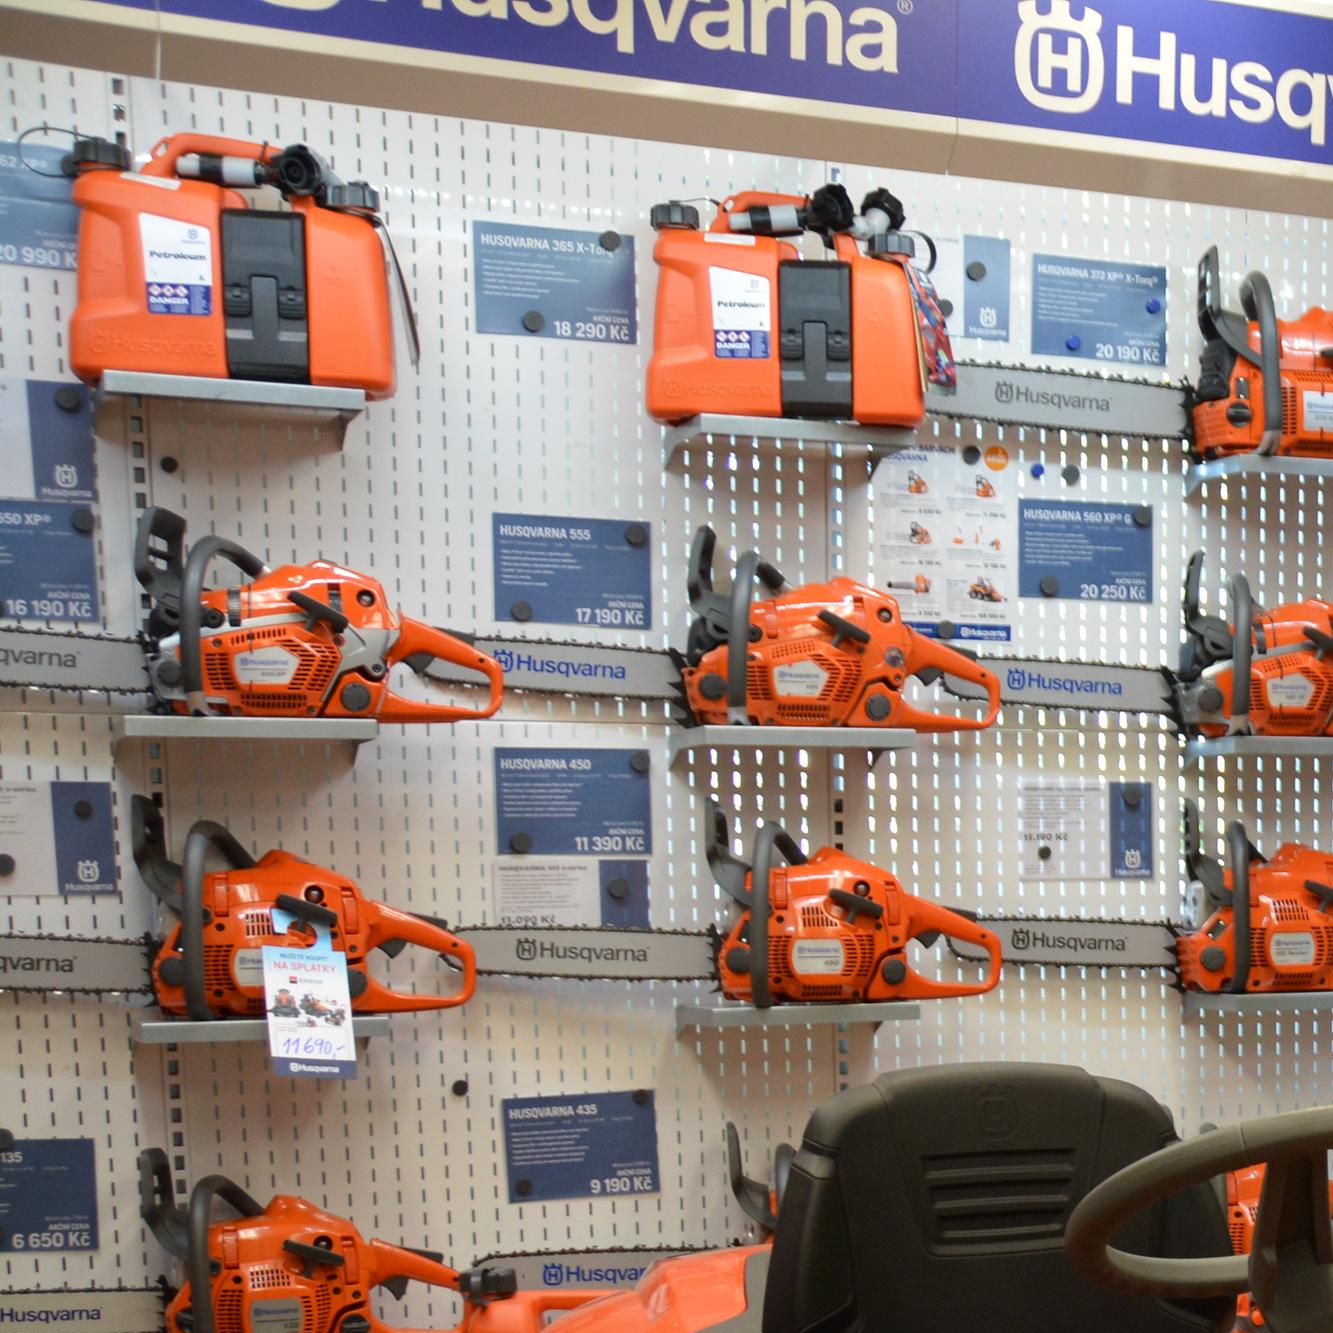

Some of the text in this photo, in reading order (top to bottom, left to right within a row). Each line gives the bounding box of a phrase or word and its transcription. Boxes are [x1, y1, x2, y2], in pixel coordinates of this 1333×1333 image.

[481, 233, 550, 250] HUSQVARNA
[552, 239, 575, 252] 365
[22, 247, 60, 265] 990
[149, 249, 207, 262] Petroleum
[1038, 264, 1105, 281] HUSQVARNA 372
[149, 296, 190, 306] DANGER
[717, 300, 766, 309] Petroleum
[554, 320, 630, 341] 18 290 Kč
[716, 341, 750, 350] DANGER
[1096, 343, 1160, 363] 20 190 Kč
[1016, 384, 1110, 412] Husqvarna
[42, 487, 93, 498] Husqvarna
[1024, 508, 1081, 521] HUSQVARNA
[1083, 510, 1101, 522] 560
[1124, 513, 1132, 524] G
[501, 525, 592, 541] HUSQVARNA 555
[70, 592, 91, 600] CENA
[1081, 584, 1147, 600] 20 250 Kč
[8, 599, 92, 617] 16 190 Kč
[575, 607, 645, 625] 17 190 Kč
[517, 655, 626, 679] Husqvarna
[1029, 672, 1122, 695] Husqvarna
[500, 757, 592, 771] HUSQVARNA 450
[575, 836, 645, 852] 11 390 Kč
[1023, 832, 1052, 842] 15.190
[65, 881, 114, 892] Husqvarna
[1032, 927, 1127, 951] Husqvarna
[539, 941, 648, 964] Husqvarna
[273, 960, 288, 970] NA
[290, 961, 336, 974] SPLÁTKY
[299, 1064, 340, 1073] Husqvarna
[509, 1104, 598, 1120] HUSQVARNA 435
[1, 1152, 23, 1163] 135
[591, 1175, 653, 1193] 9 190 Kč
[69, 1222, 91, 1231] CENA
[12, 1231, 91, 1248] 6 650 Kč
[0, 1307, 101, 1323] Husqvarna
